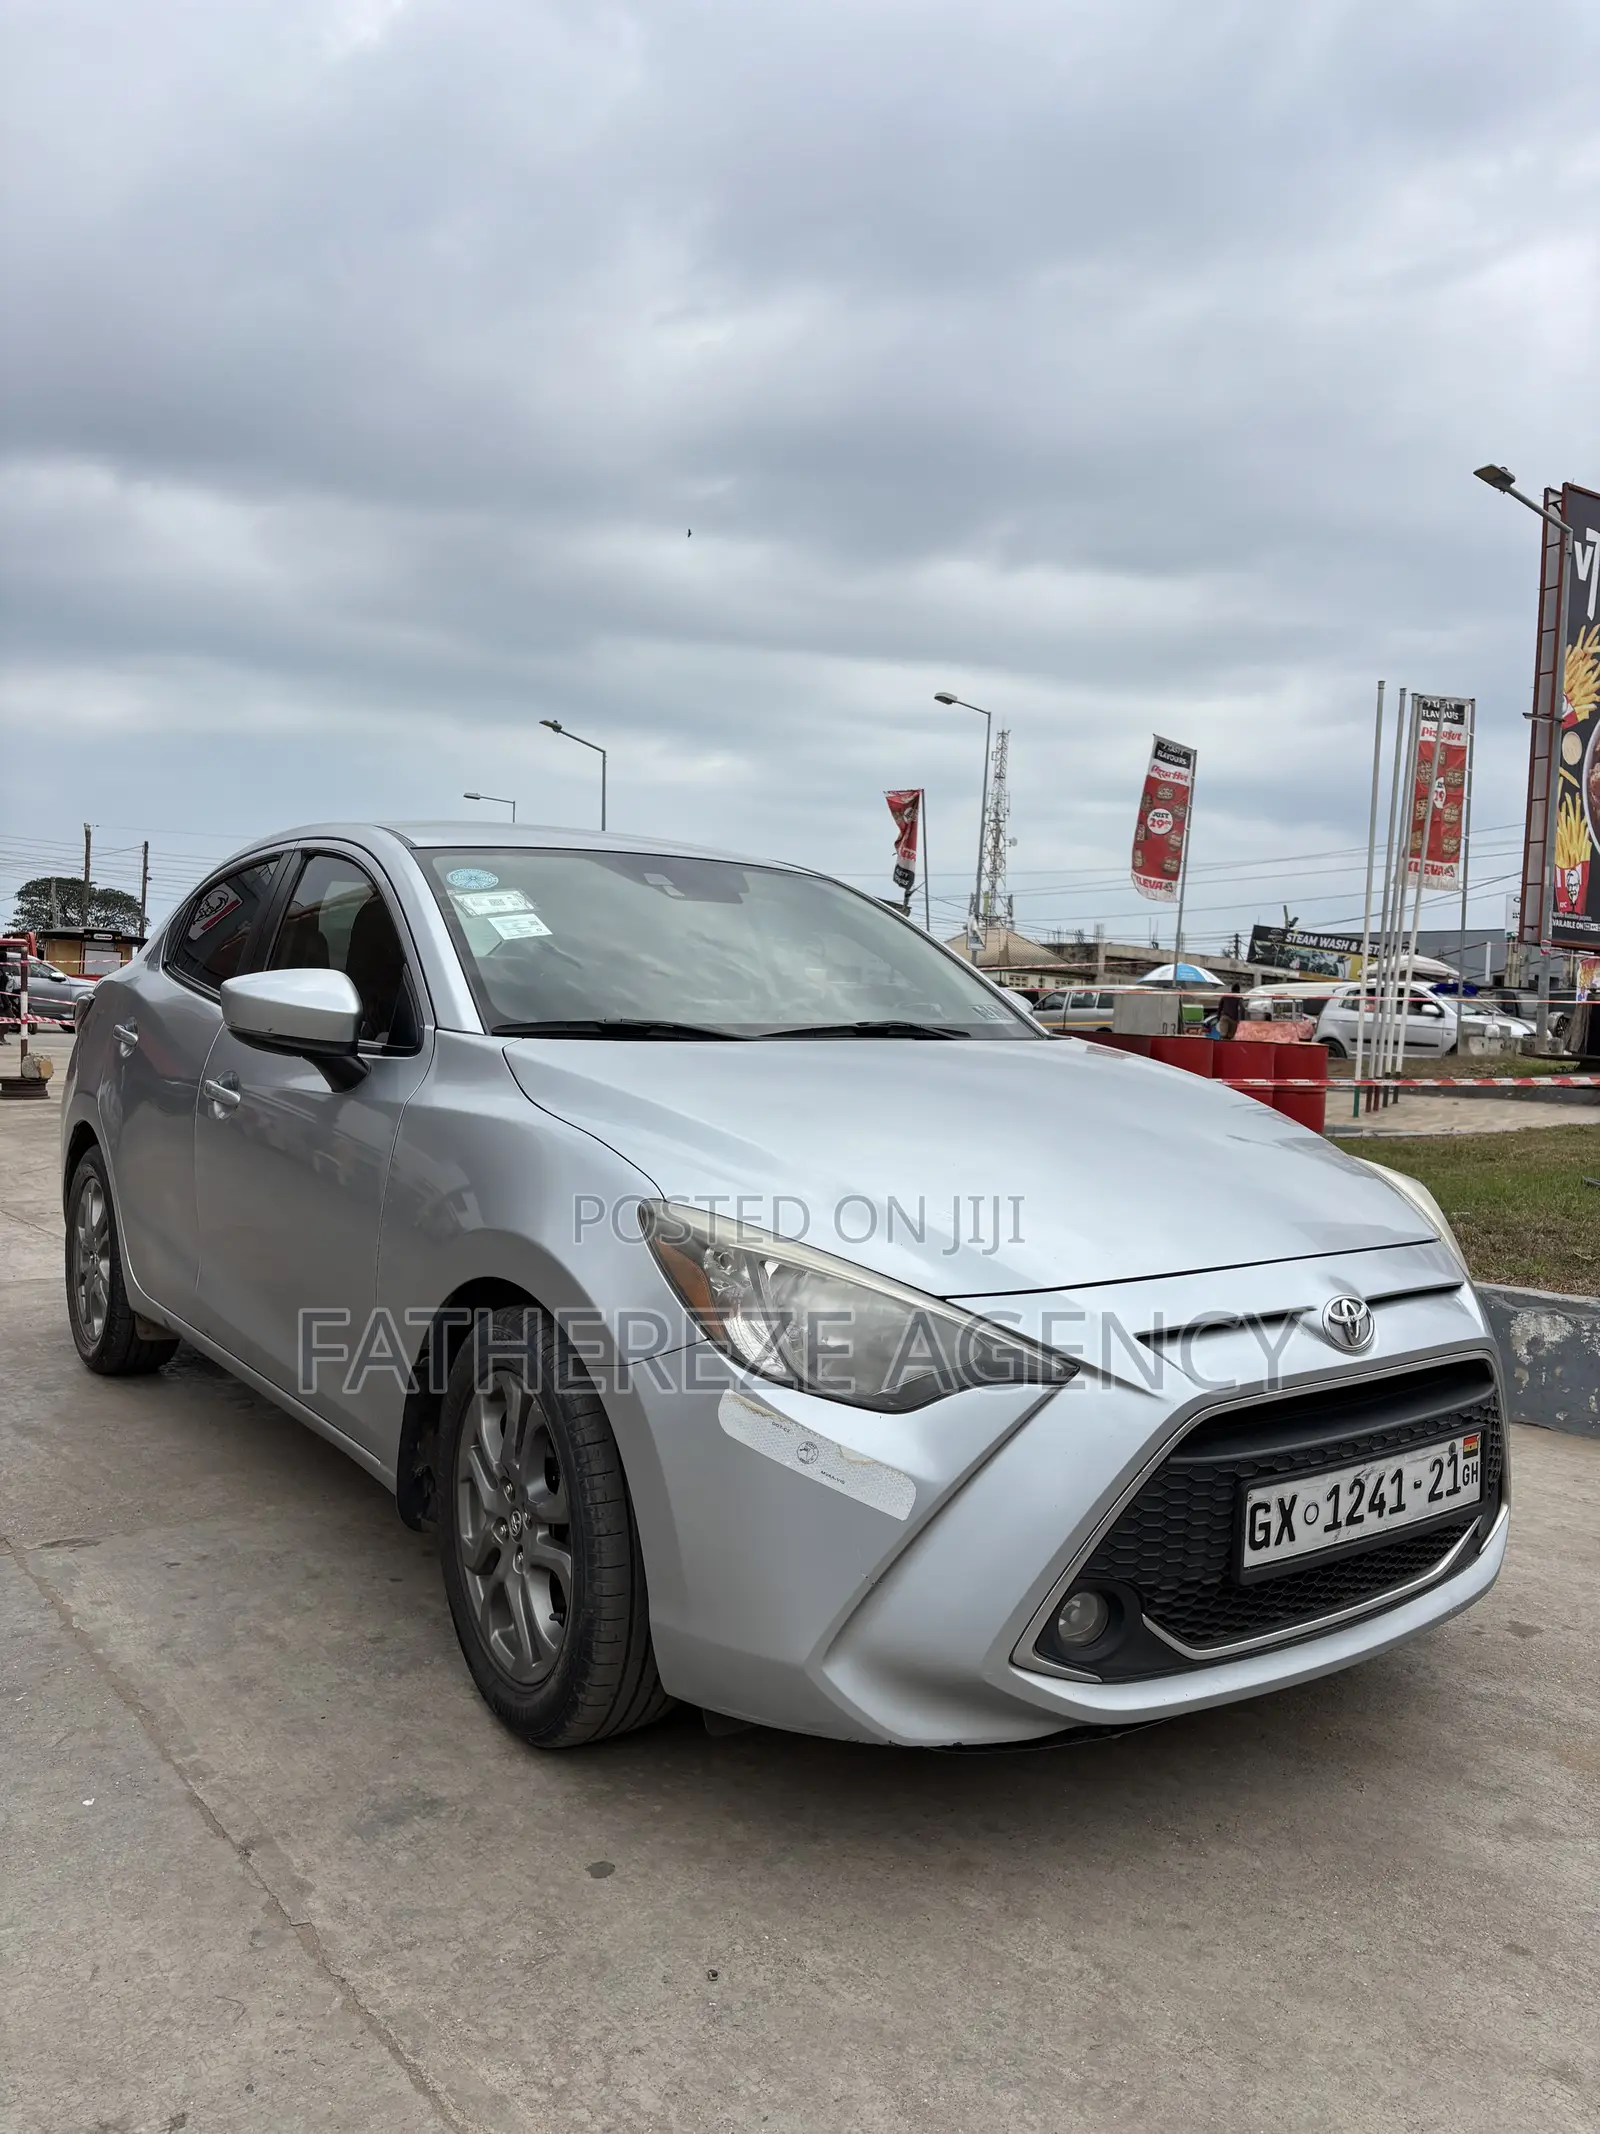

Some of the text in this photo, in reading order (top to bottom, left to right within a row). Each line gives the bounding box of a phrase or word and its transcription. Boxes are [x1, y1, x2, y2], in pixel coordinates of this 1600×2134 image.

[1157, 749, 1187, 765] FLAVOURS
[1576, 922, 1584, 930] ON
[1285, 932, 1318, 946] STEAM
[1319, 937, 1350, 951] WASH
[1350, 941, 1358, 951] &
[1248, 1494, 1298, 1552] GX
[1462, 1460, 1479, 1487] GH
